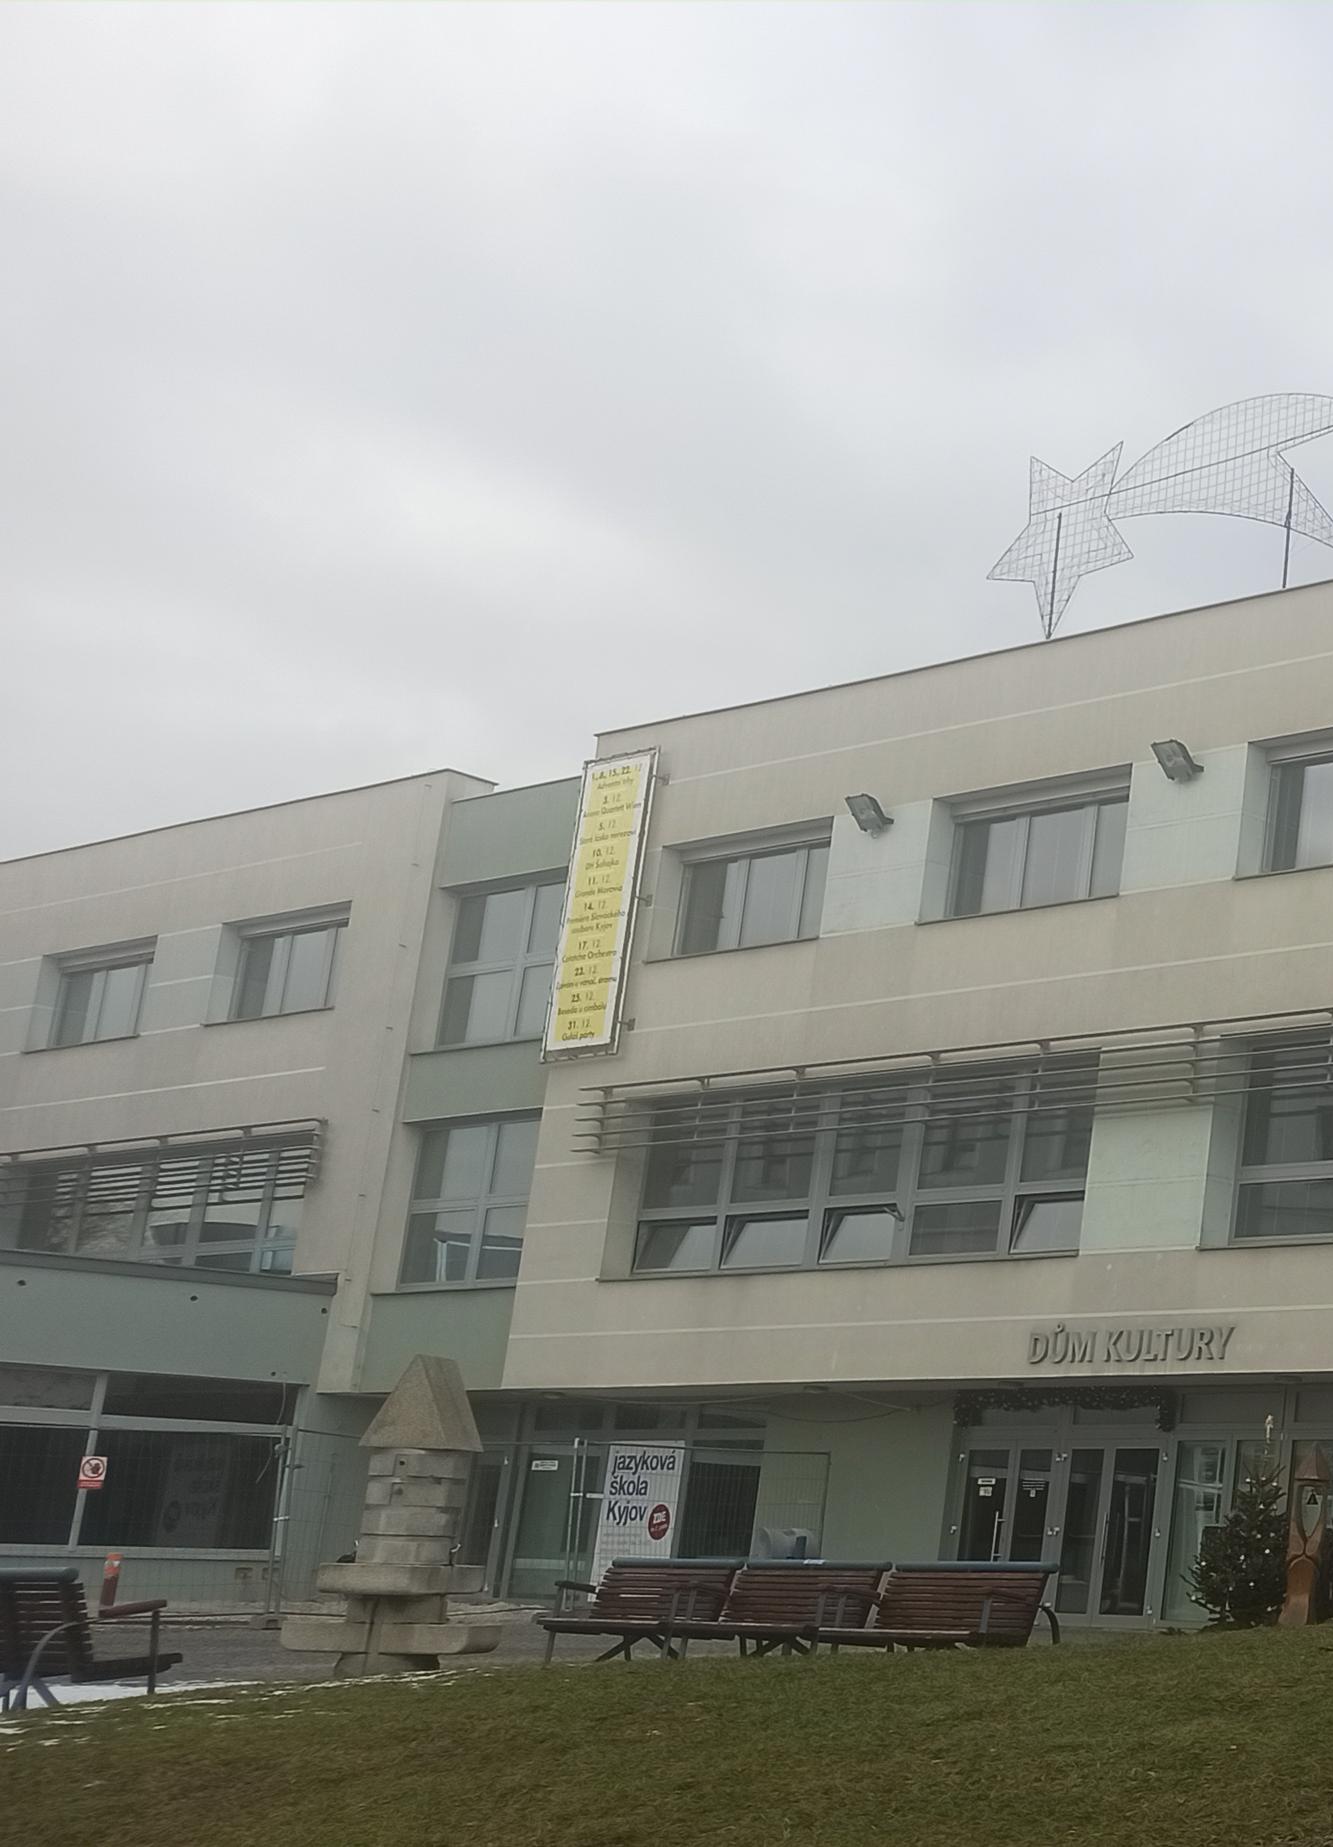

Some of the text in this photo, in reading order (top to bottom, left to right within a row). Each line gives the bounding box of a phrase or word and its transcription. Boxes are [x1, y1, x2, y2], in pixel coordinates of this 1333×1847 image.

[1028, 1322, 1237, 1364] DŮM KULTURY
[612, 1450, 676, 1475] jazyková
[609, 1475, 648, 1496] škola
[606, 1501, 647, 1526] Kyjov
